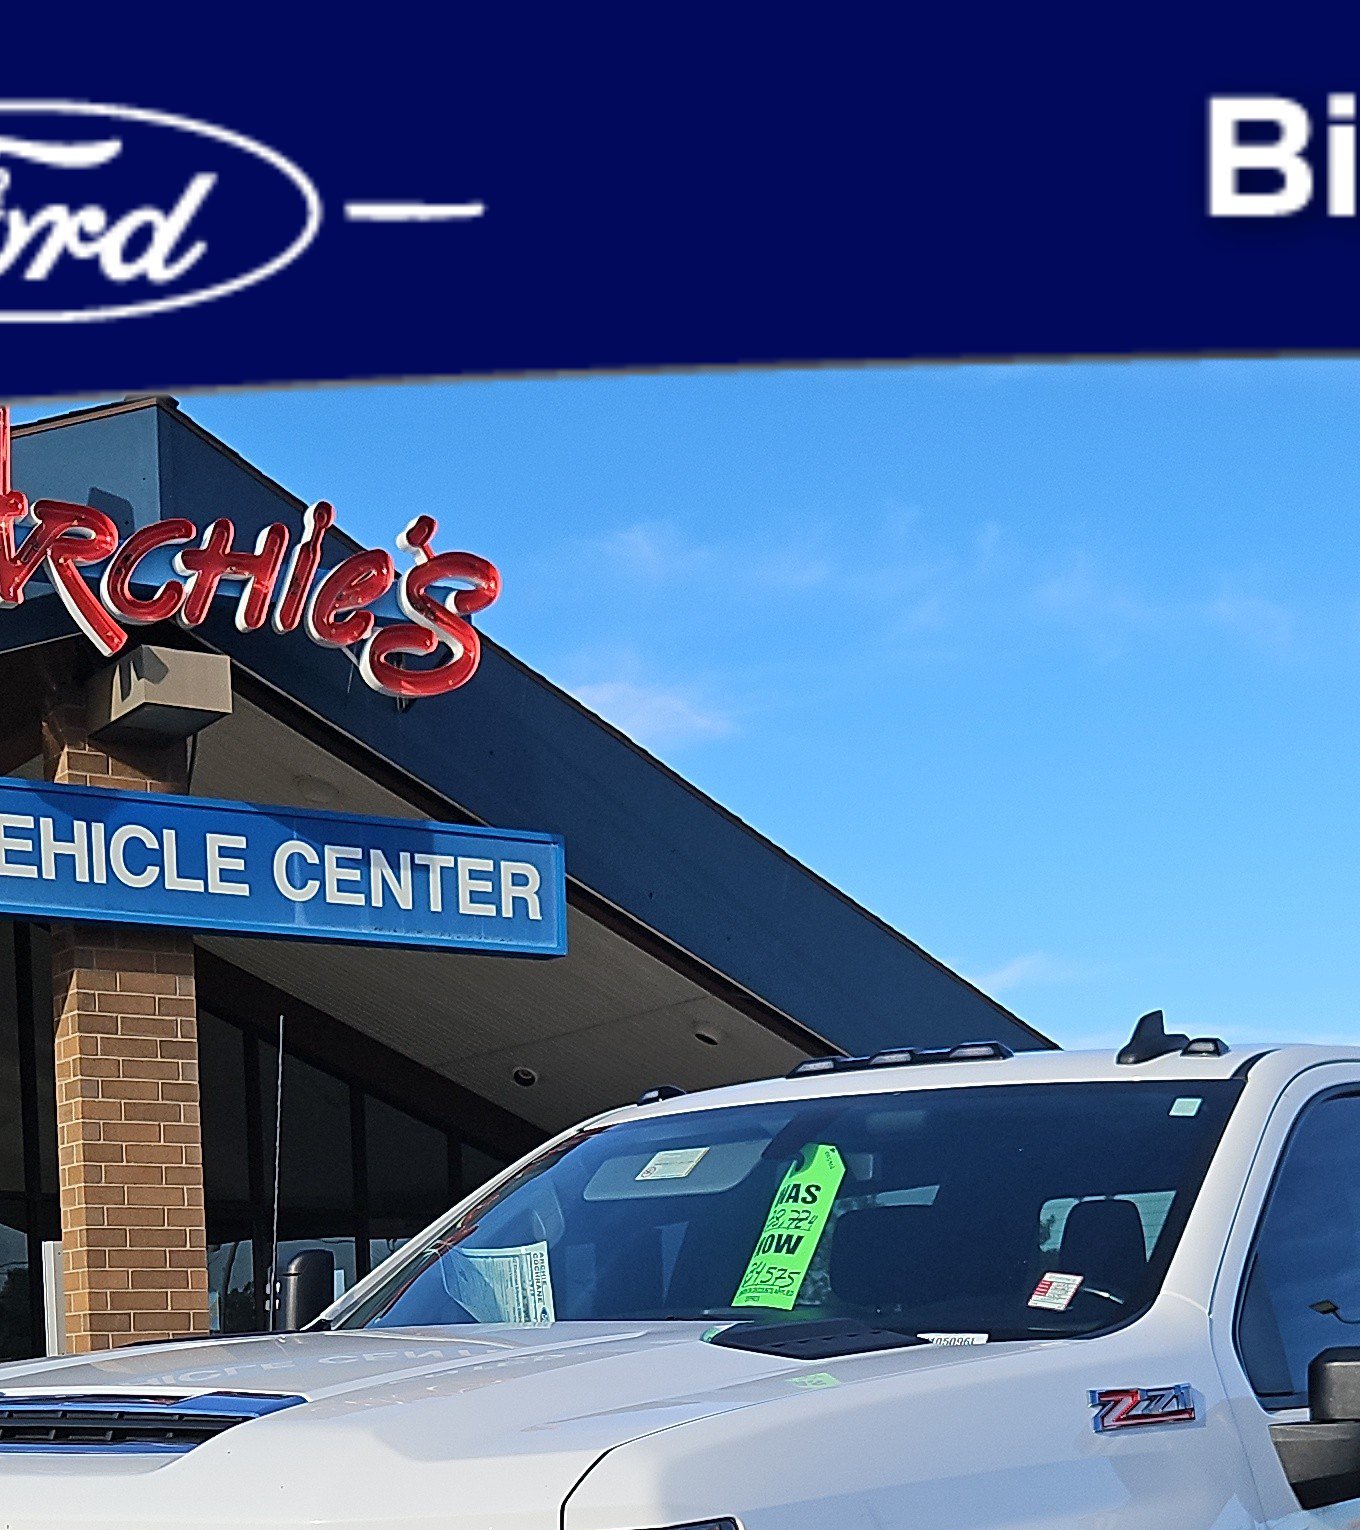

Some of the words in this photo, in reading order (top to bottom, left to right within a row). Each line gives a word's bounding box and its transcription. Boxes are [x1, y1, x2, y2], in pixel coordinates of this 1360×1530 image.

[273, 840, 543, 921] CENTER
[532, 1252, 543, 1304] COCHRANE
[1086, 1382, 1196, 1433] Z71
